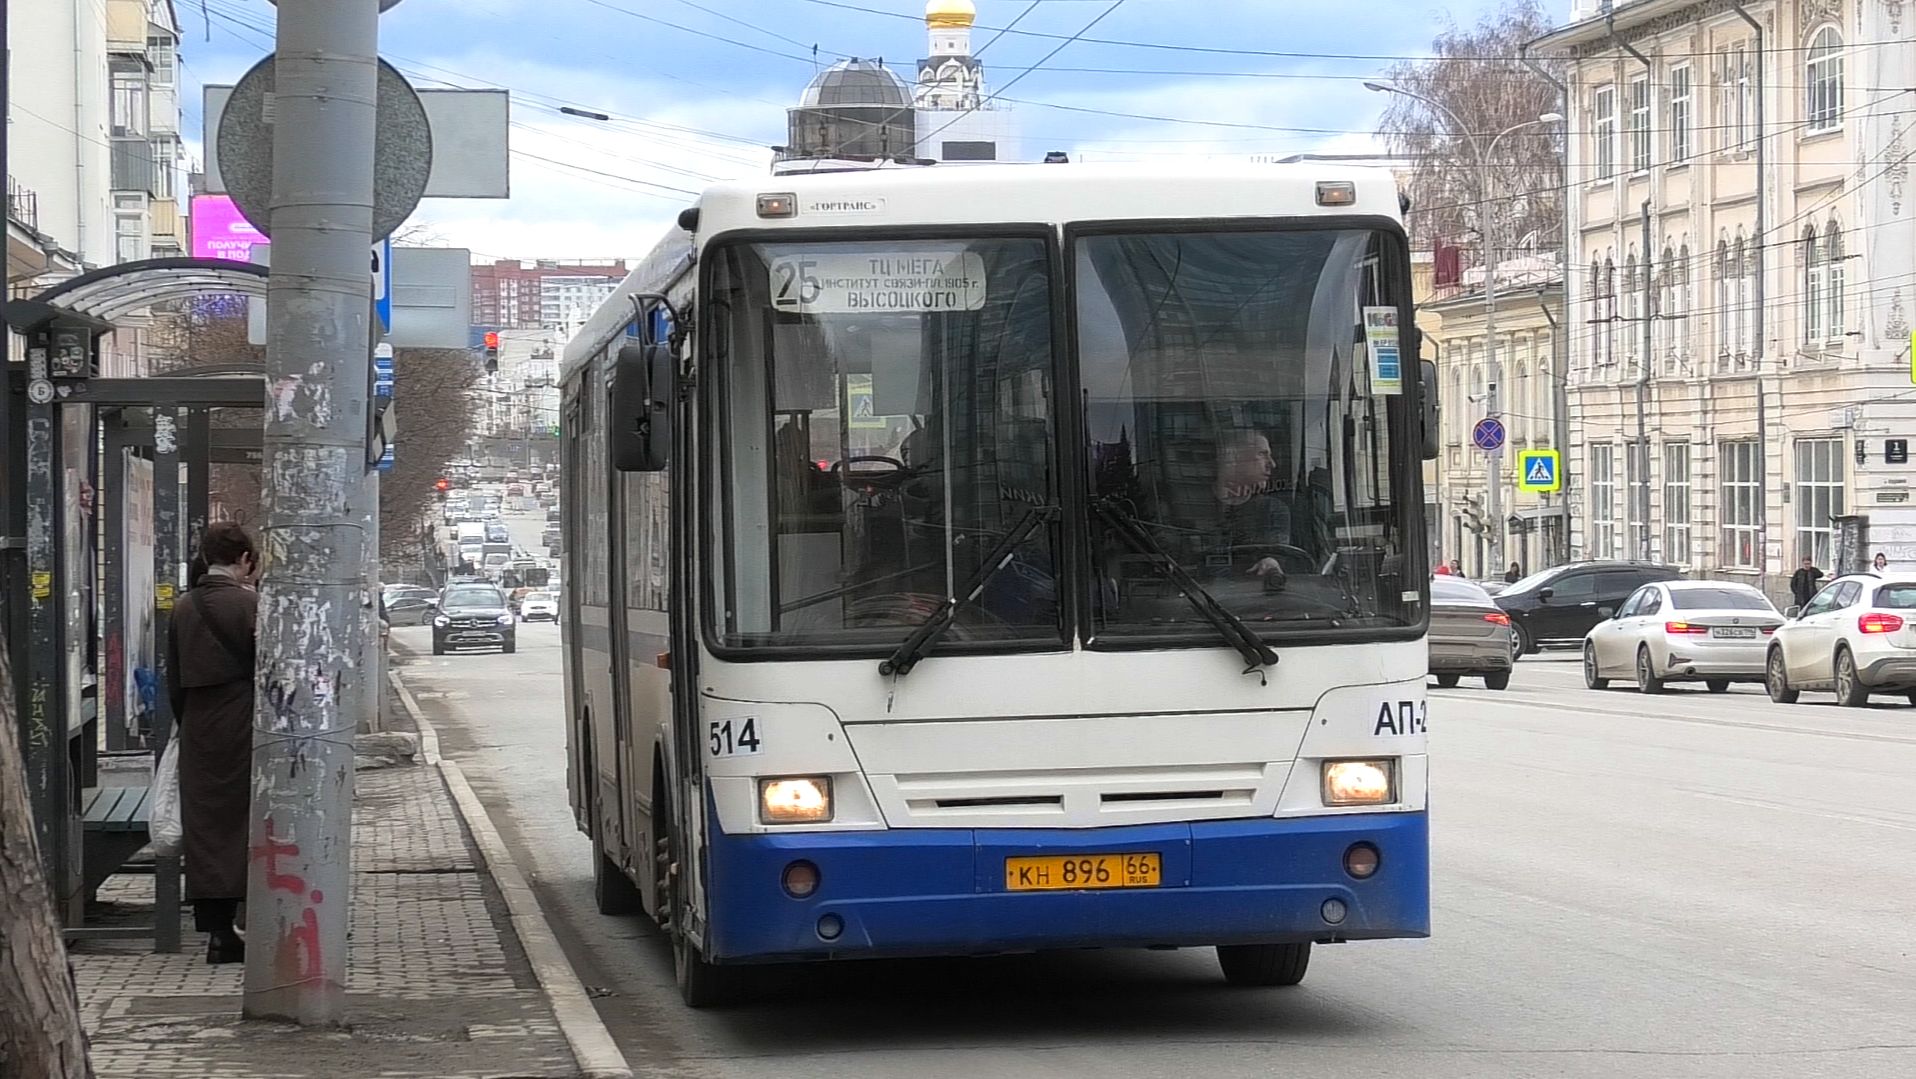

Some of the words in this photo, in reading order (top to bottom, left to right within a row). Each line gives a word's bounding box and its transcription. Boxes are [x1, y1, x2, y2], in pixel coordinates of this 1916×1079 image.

[869, 259, 890, 276] ТЦ
[897, 259, 944, 275] МЕГА
[775, 260, 821, 305] 25
[821, 278, 879, 289] ИНСТИТУТ
[848, 291, 956, 308] ВЫСОЦКОГО
[710, 718, 760, 756] 514
[1019, 866, 1049, 886] КН
[1062, 859, 1110, 884] 896
[1127, 856, 1150, 875] 66
[1129, 875, 1148, 884] RUS
